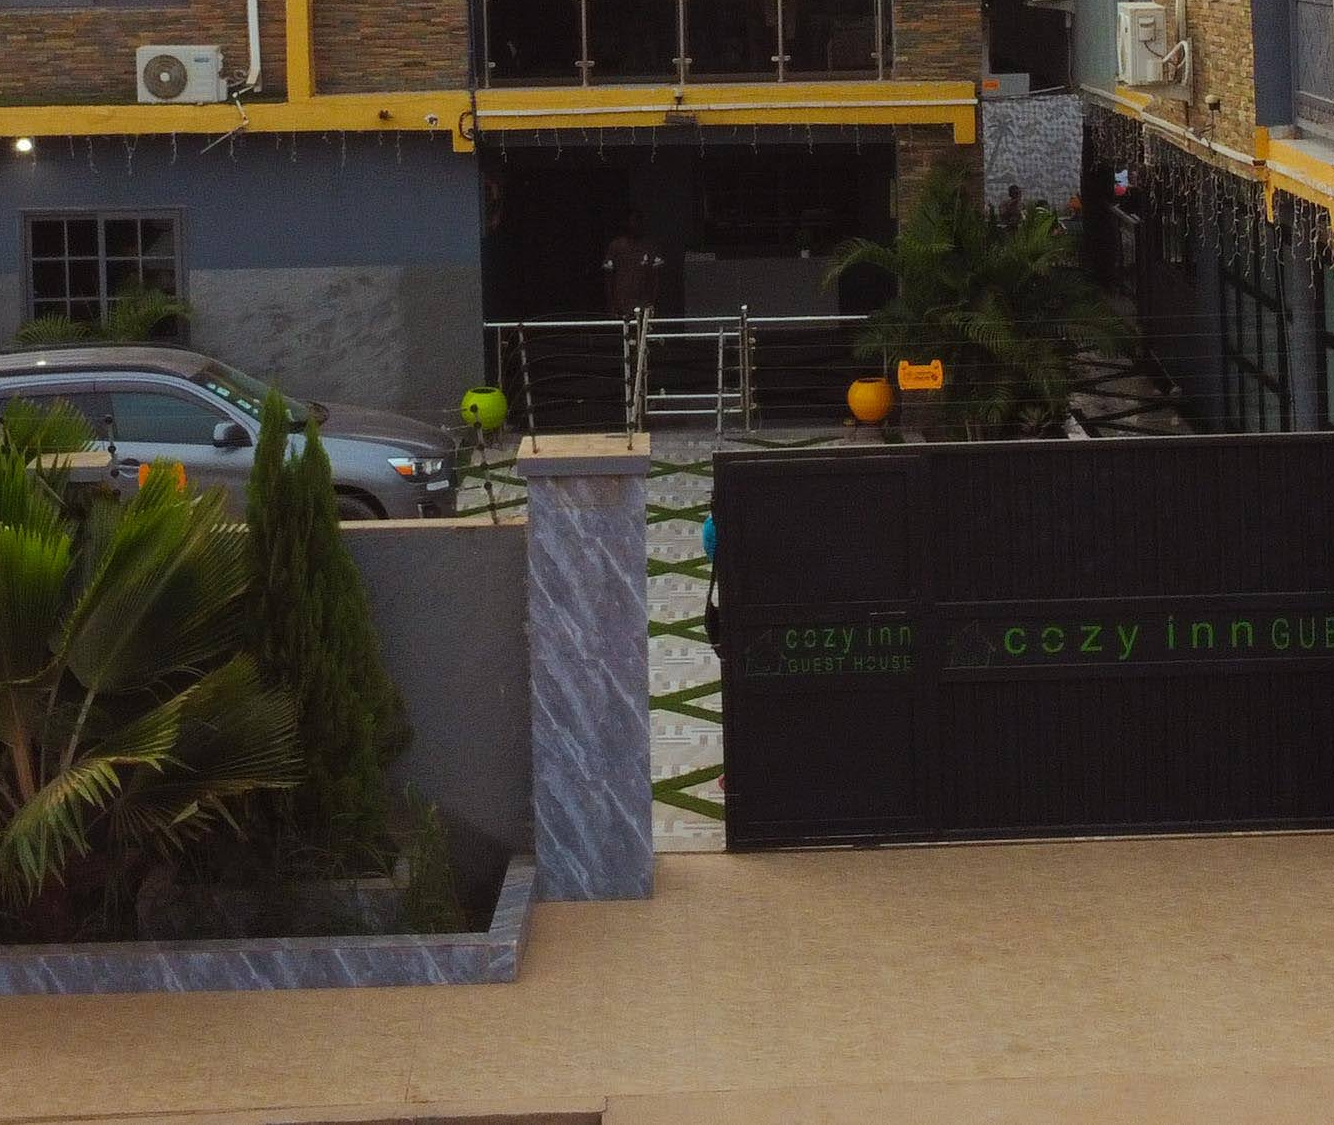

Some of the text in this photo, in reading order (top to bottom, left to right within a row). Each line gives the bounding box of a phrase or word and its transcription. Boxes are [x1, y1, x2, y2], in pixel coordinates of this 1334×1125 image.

[785, 625, 913, 654] cozy inn
[1003, 622, 1140, 661] cozy
[1166, 615, 1254, 650] inn
[787, 655, 915, 674] GUEST HOUSE
